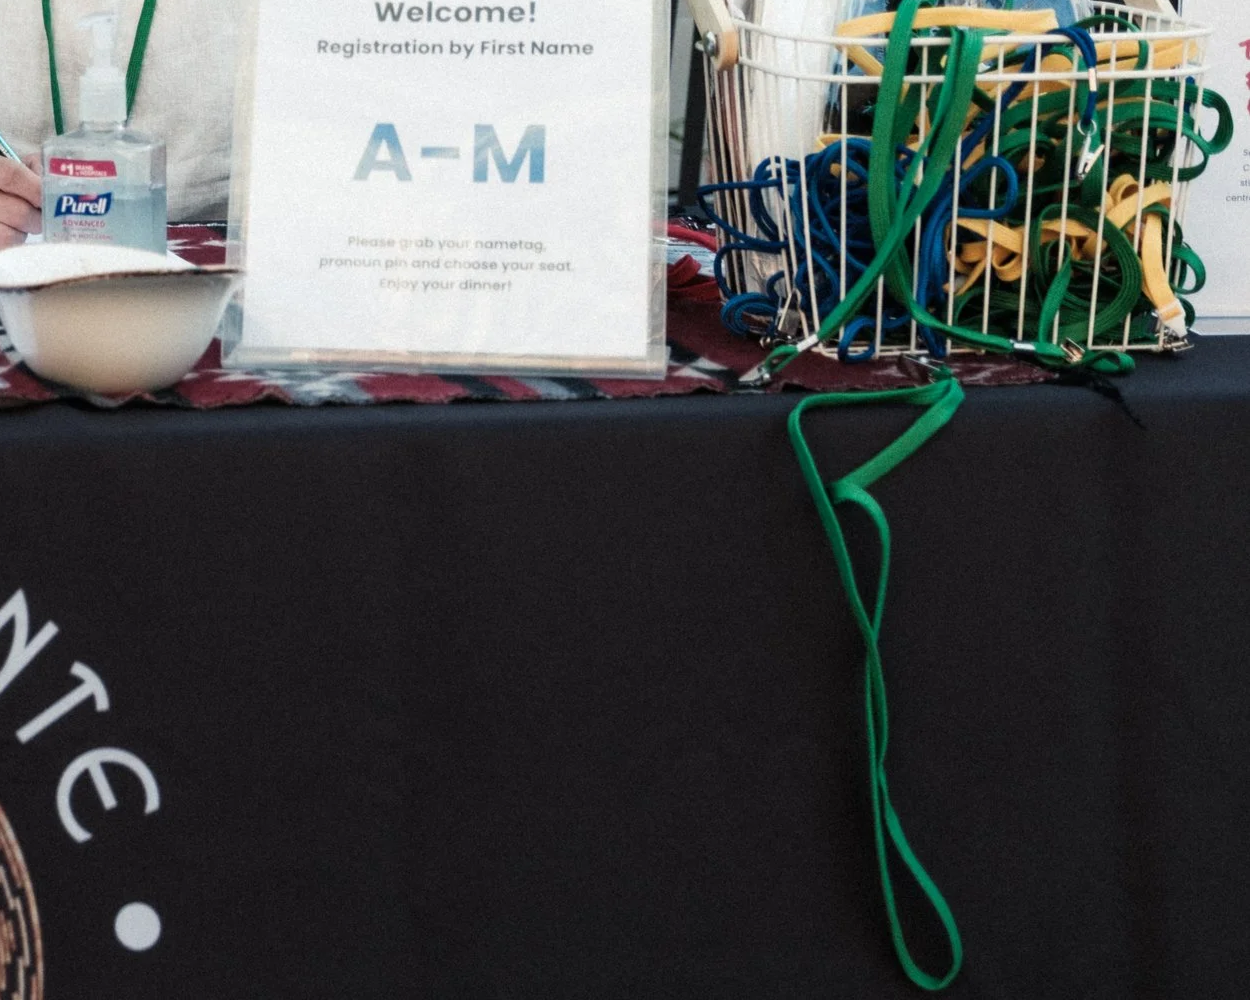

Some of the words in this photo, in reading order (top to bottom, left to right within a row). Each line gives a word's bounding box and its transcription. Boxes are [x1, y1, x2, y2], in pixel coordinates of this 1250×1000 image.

[374, 1, 537, 24] Welcome!
[317, 38, 444, 60] Registration
[450, 39, 475, 60] by
[480, 39, 526, 56] First
[530, 40, 594, 56] Name
[61, 196, 107, 214] Purell
[1225, 193, 1250, 202] centr
[347, 235, 396, 249] Please
[399, 236, 435, 251] grab
[438, 238, 469, 251] your
[318, 256, 382, 270] pronoun
[384, 258, 408, 271] pin
[411, 257, 441, 270] and
[443, 258, 499, 271] choose
[501, 261, 535, 274] your
[378, 277, 419, 293] Enjoy
[421, 280, 455, 293] your
[458, 279, 513, 292] dinner!
